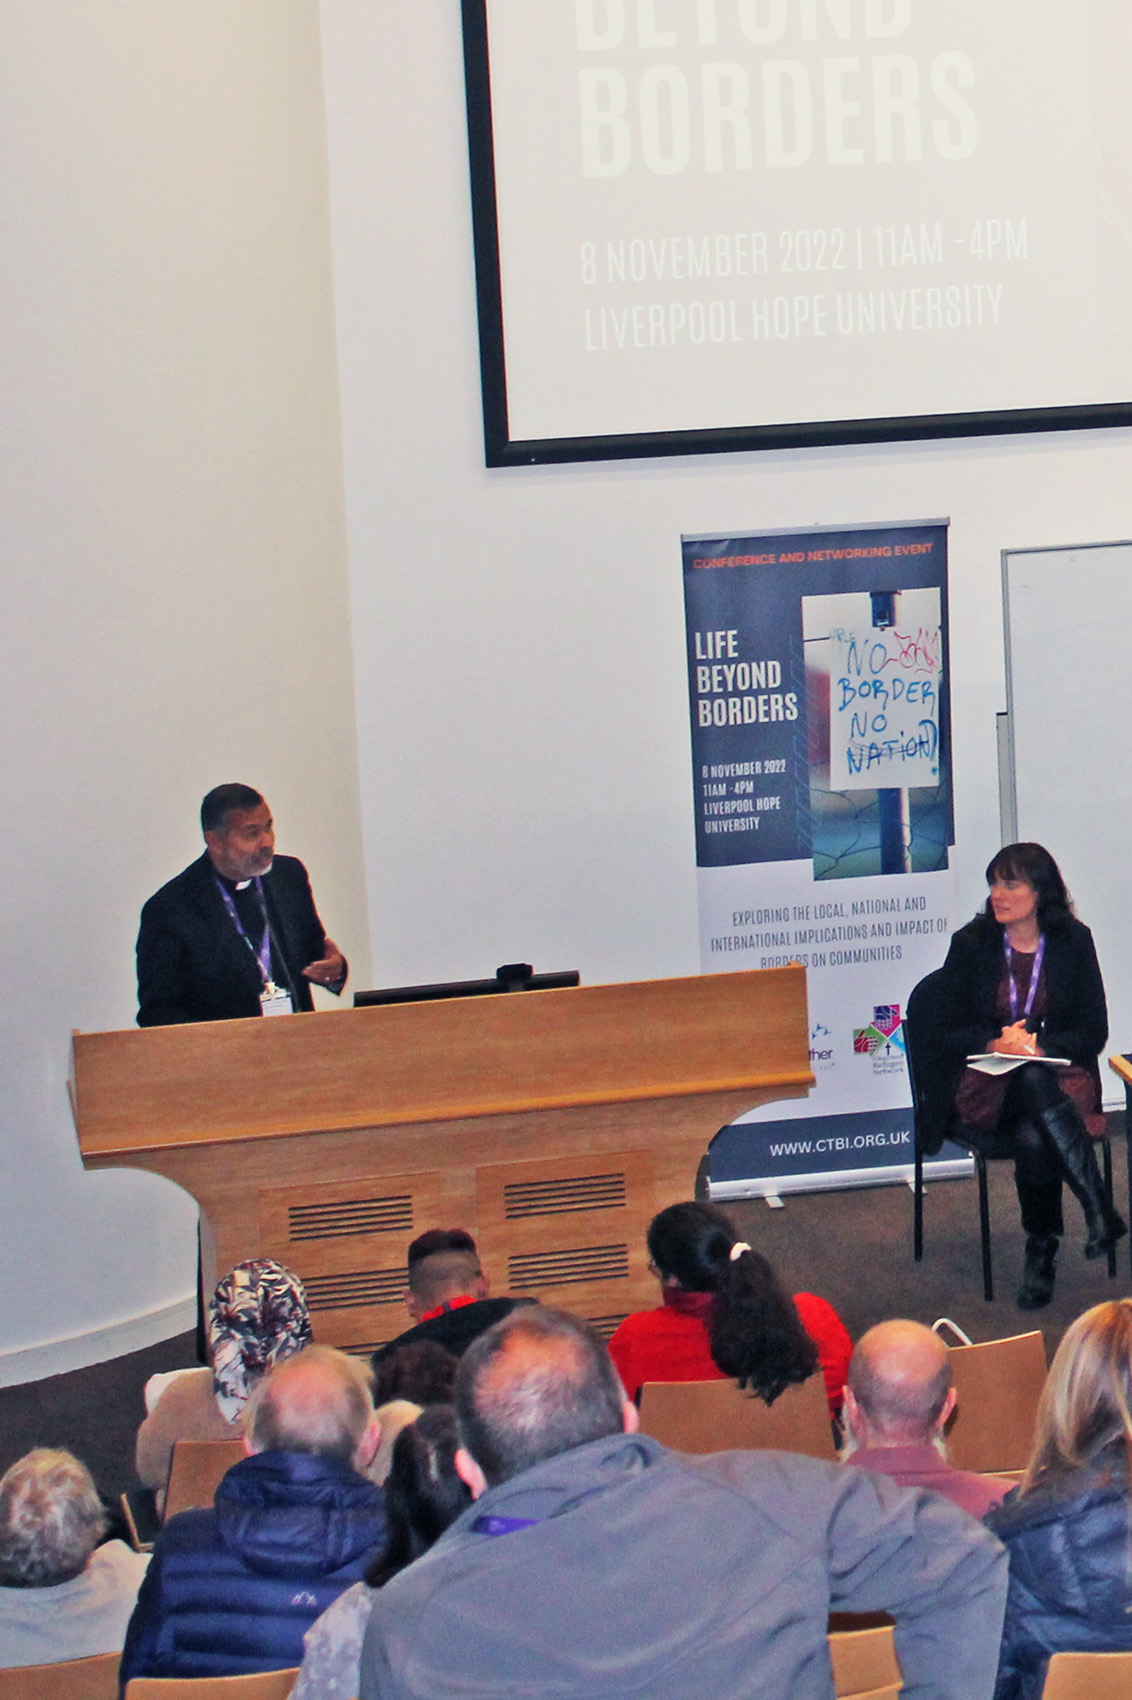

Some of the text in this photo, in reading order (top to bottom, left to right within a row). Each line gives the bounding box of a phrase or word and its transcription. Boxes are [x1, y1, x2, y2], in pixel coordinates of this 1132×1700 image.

[578, 50, 978, 179] BORDERS
[580, 241, 597, 286] 8
[606, 231, 769, 283] NOVEMBER
[780, 227, 845, 273] 2022
[874, 221, 943, 267] 11AM
[584, 283, 1003, 351] LIVERPOOL HOPE UNIVERSITY
[693, 543, 934, 569] CONFERENCE AND NETWORKING EVENT
[694, 629, 739, 659] LIFE
[847, 638, 887, 676] NO
[697, 660, 782, 693] BEYOND
[698, 692, 799, 727] BORDERS
[837, 677, 936, 717] BORDER
[851, 711, 887, 738] NO
[702, 759, 786, 778] 8 NOVEMBER 2022
[703, 782, 727, 797] 11AM
[703, 796, 781, 815] LIVERPOOL HOPE
[704, 816, 760, 834] UNIVERSITY
[732, 896, 927, 927] EXPLORING THE LOCAL, NATIONAL AND
[711, 917, 948, 952] INTERNATIONAL IMPLICATIONS AND IMPACT OF
[812, 952, 826, 968] ON
[829, 945, 902, 966] COMMUNITIES
[769, 1130, 911, 1157] WWW.CTBI.ORG.UK
